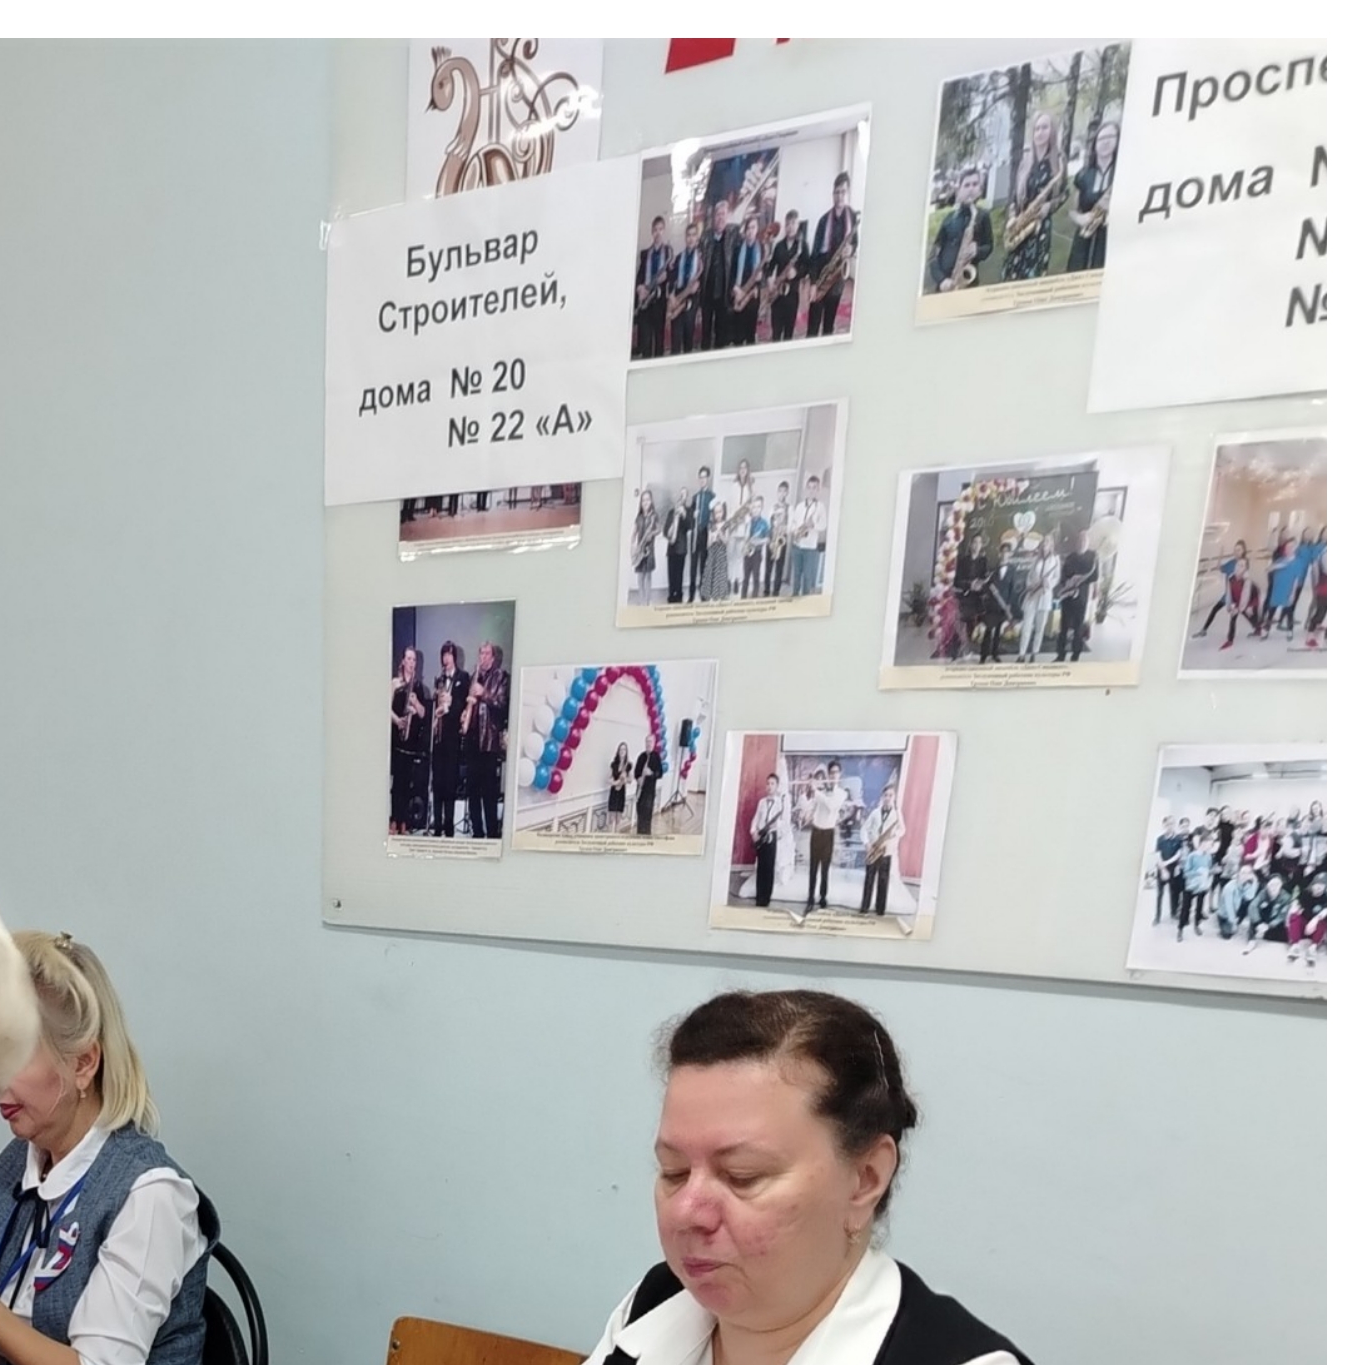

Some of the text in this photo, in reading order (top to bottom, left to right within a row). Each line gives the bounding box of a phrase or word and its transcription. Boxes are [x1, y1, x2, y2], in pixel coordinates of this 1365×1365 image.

[1138, 165, 1274, 224] дома
[407, 229, 538, 282] Бульвар
[378, 271, 566, 336] Строителей,
[359, 358, 526, 416] дома № 20
[448, 403, 592, 447] № 22 «А»
